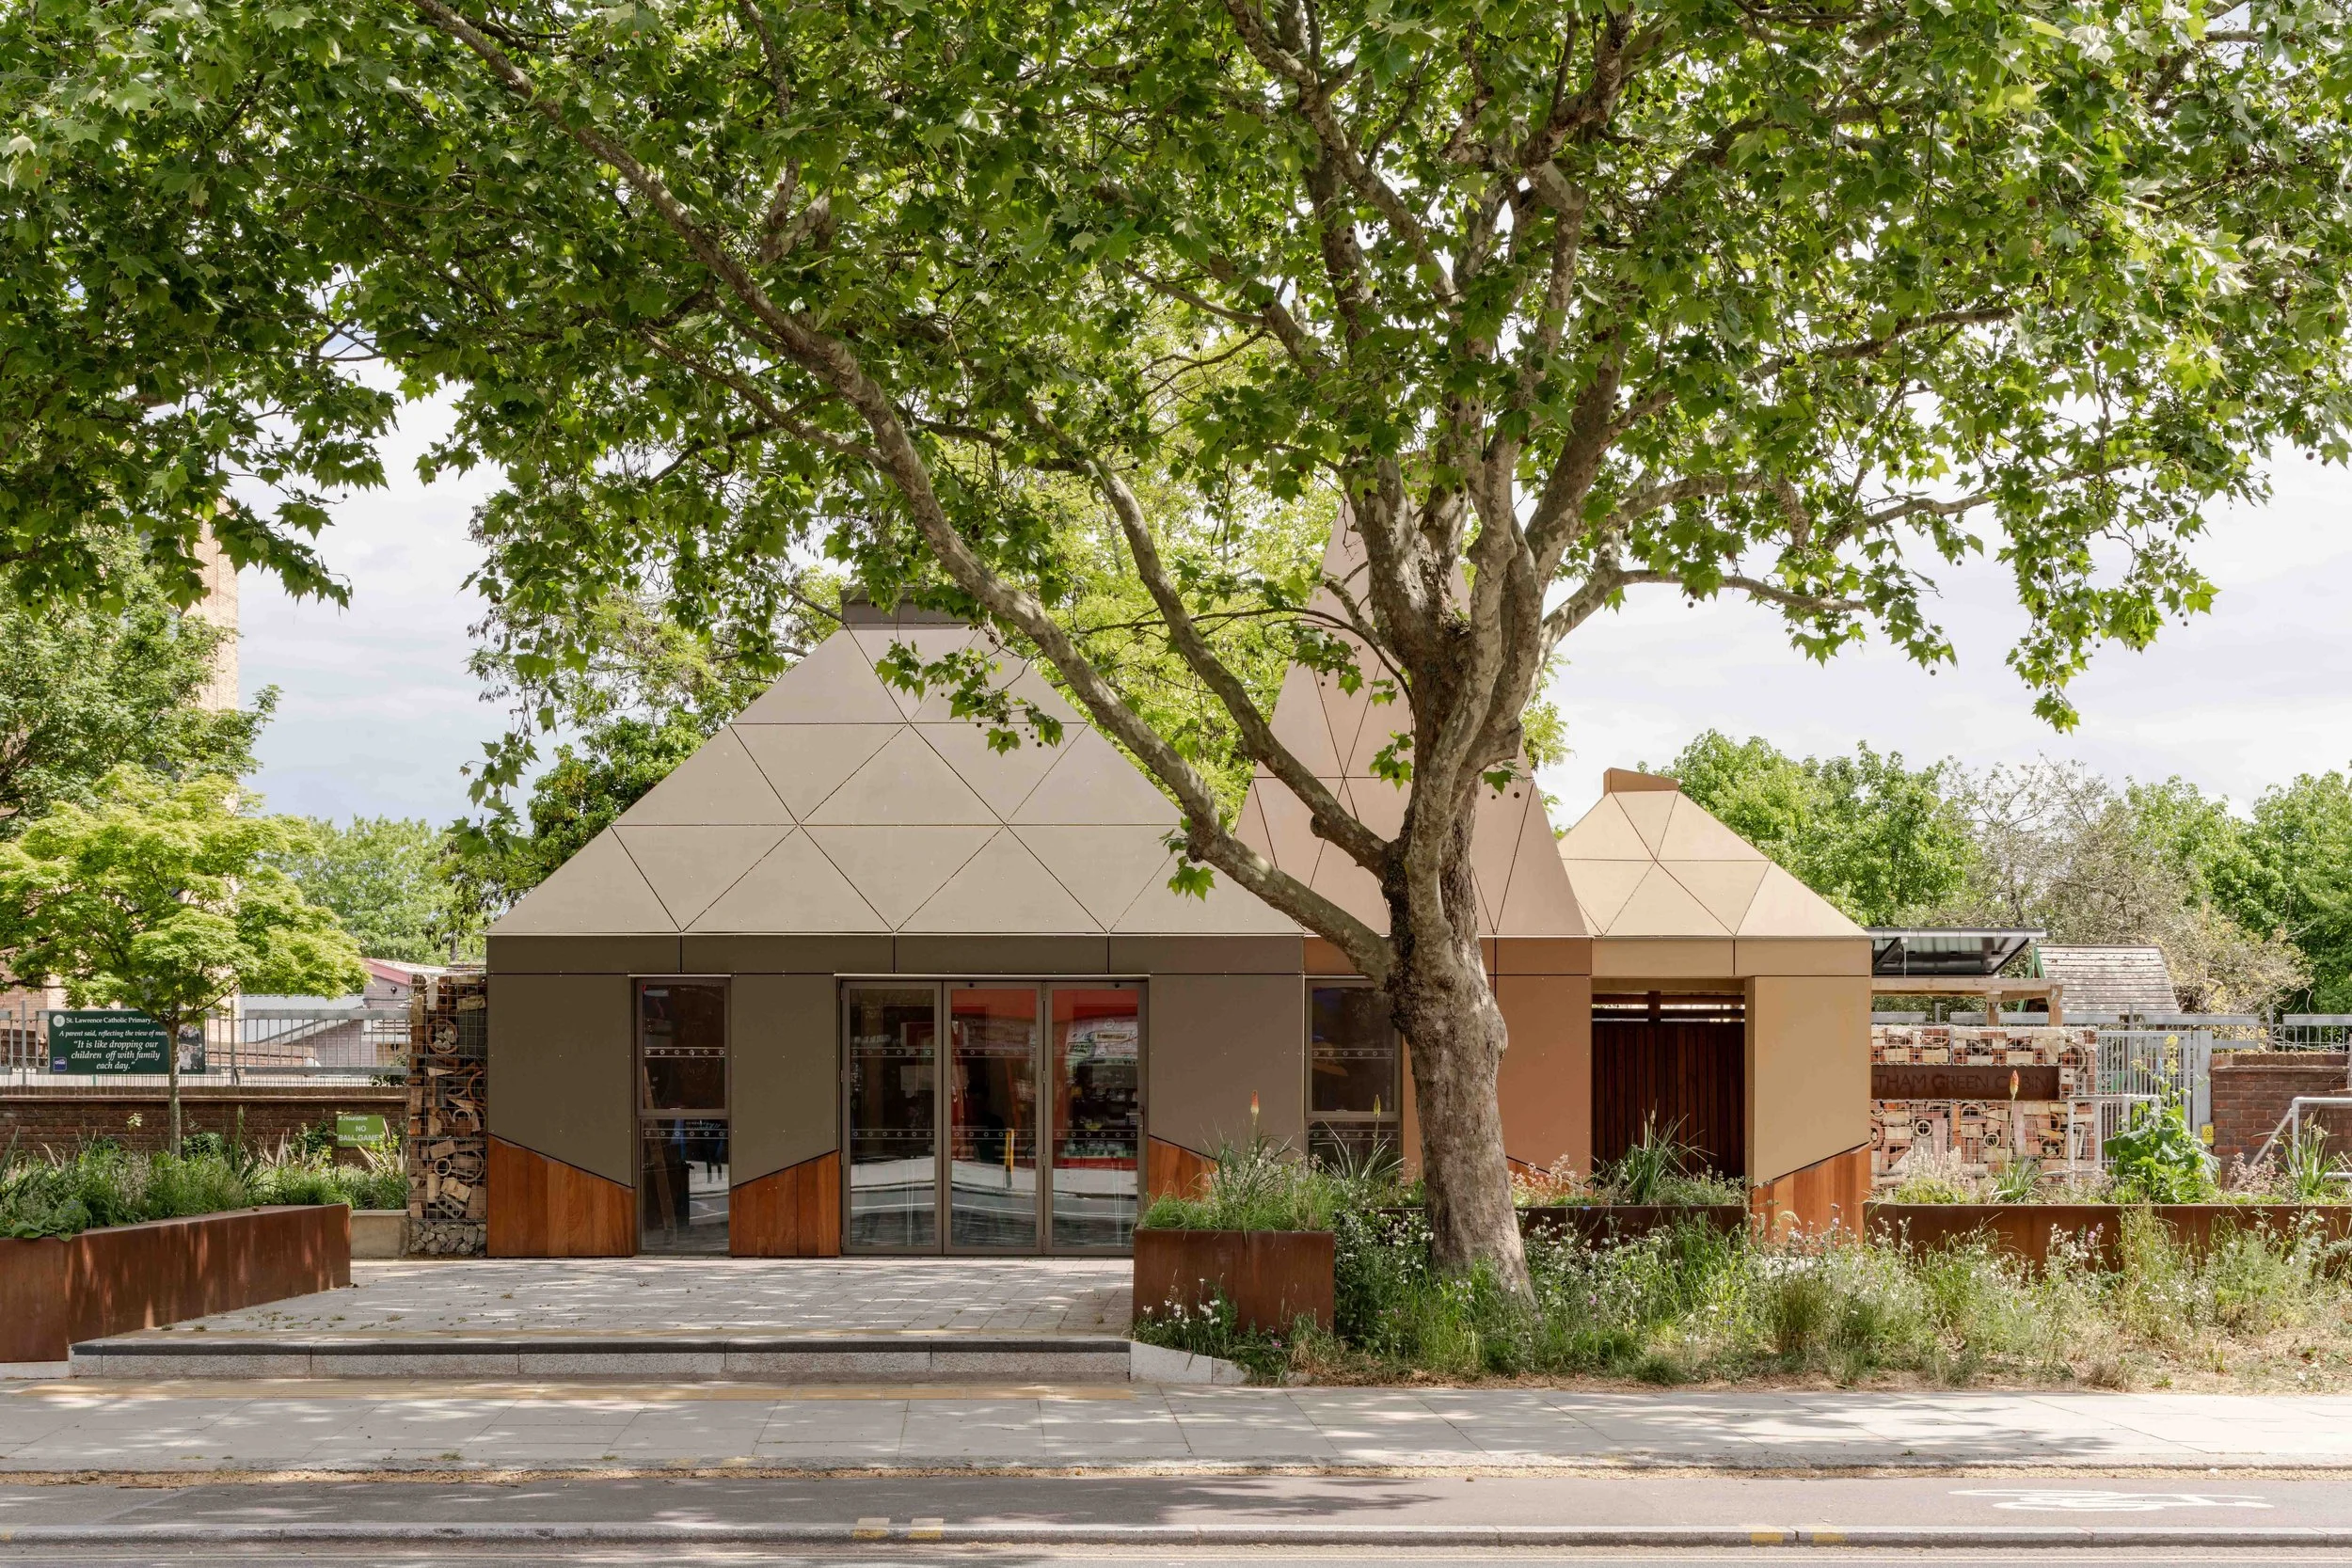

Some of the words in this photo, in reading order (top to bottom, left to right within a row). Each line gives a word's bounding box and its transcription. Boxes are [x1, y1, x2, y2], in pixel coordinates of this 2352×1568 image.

[99, 1030, 124, 1038] reflecting
[109, 1040, 143, 1050] dropping
[71, 1051, 102, 1059] children
[105, 1051, 117, 1061] off
[117, 1051, 135, 1059] with
[135, 1051, 160, 1061] family
[96, 1061, 113, 1069] each
[1872, 1074, 1926, 1090] THAM
[1931, 1074, 1989, 1090] GREEN
[1994, 1075, 2049, 1090] CBIN
